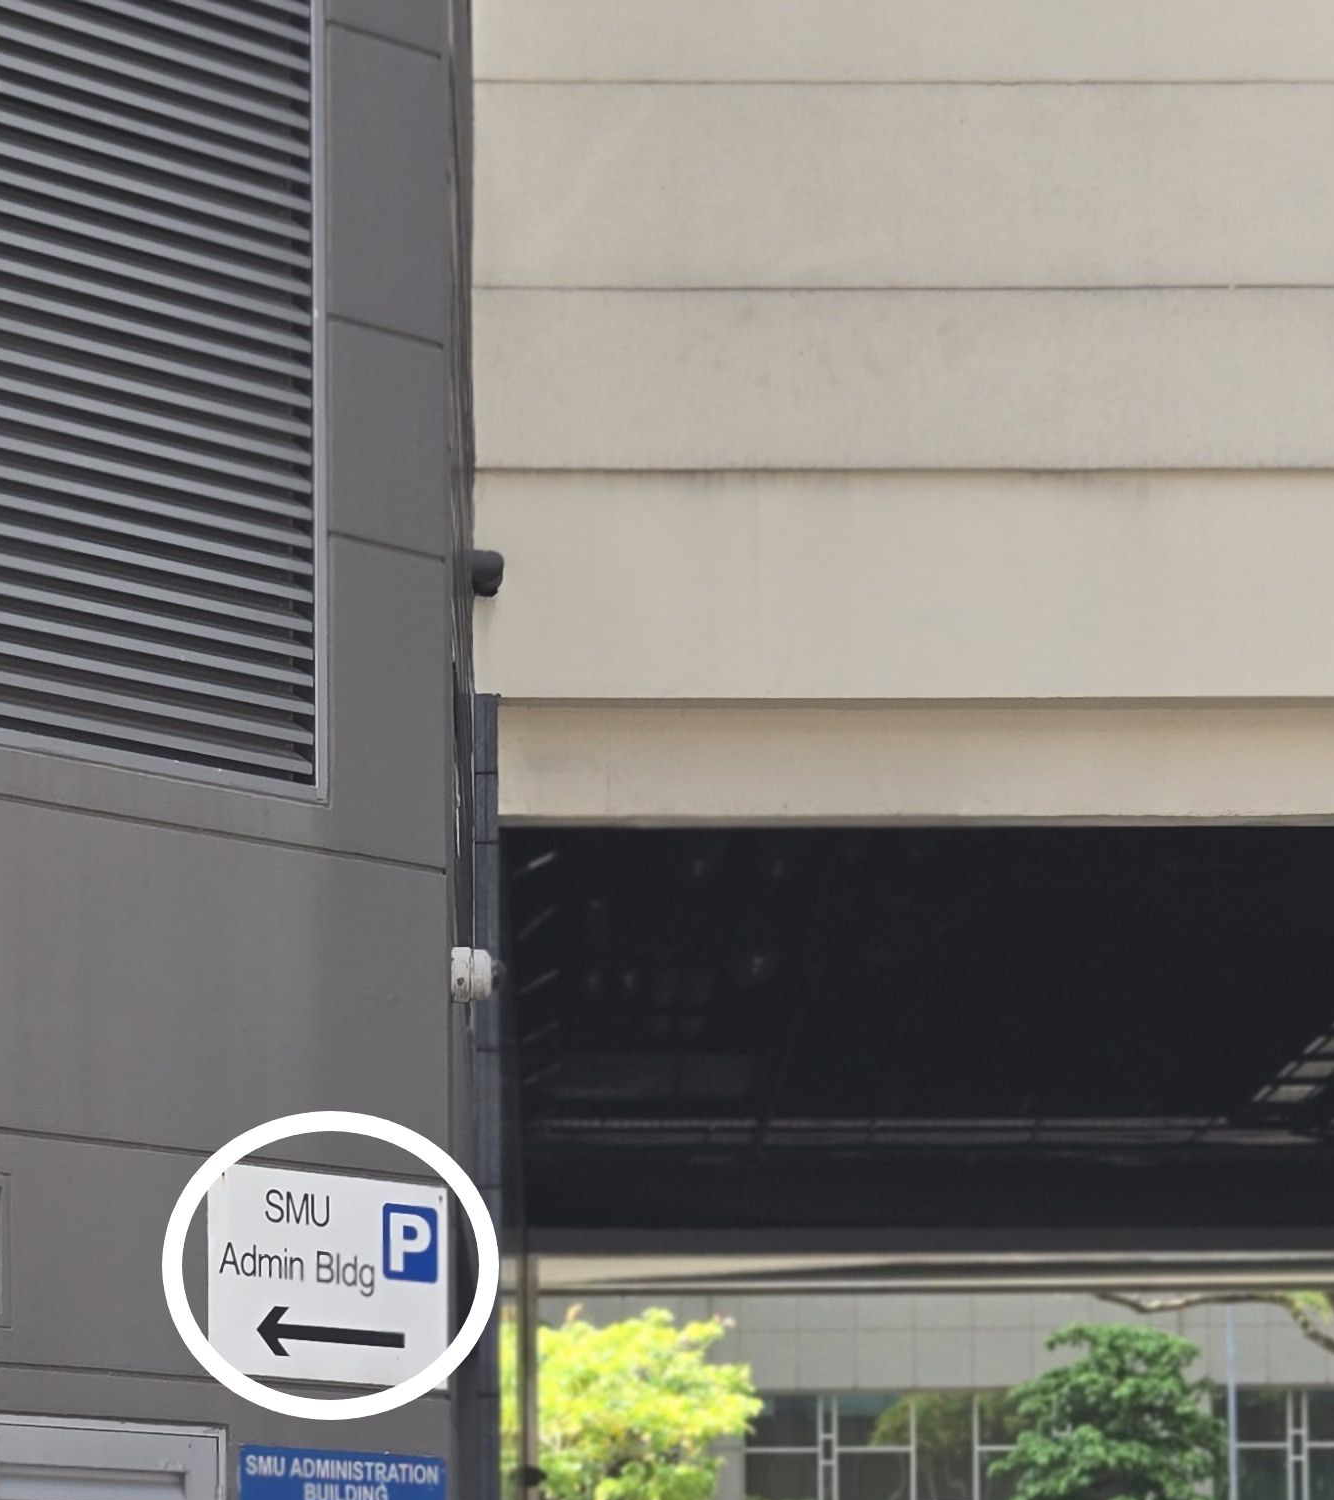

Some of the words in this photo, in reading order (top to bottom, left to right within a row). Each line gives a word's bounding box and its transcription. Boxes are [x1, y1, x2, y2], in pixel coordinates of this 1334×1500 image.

[264, 1188, 331, 1228] SMU
[389, 1212, 432, 1273] P
[219, 1241, 305, 1282] Admin
[316, 1250, 375, 1297] Bldg
[245, 1455, 286, 1477] SMU
[290, 1457, 440, 1485] ADMINISTRATION
